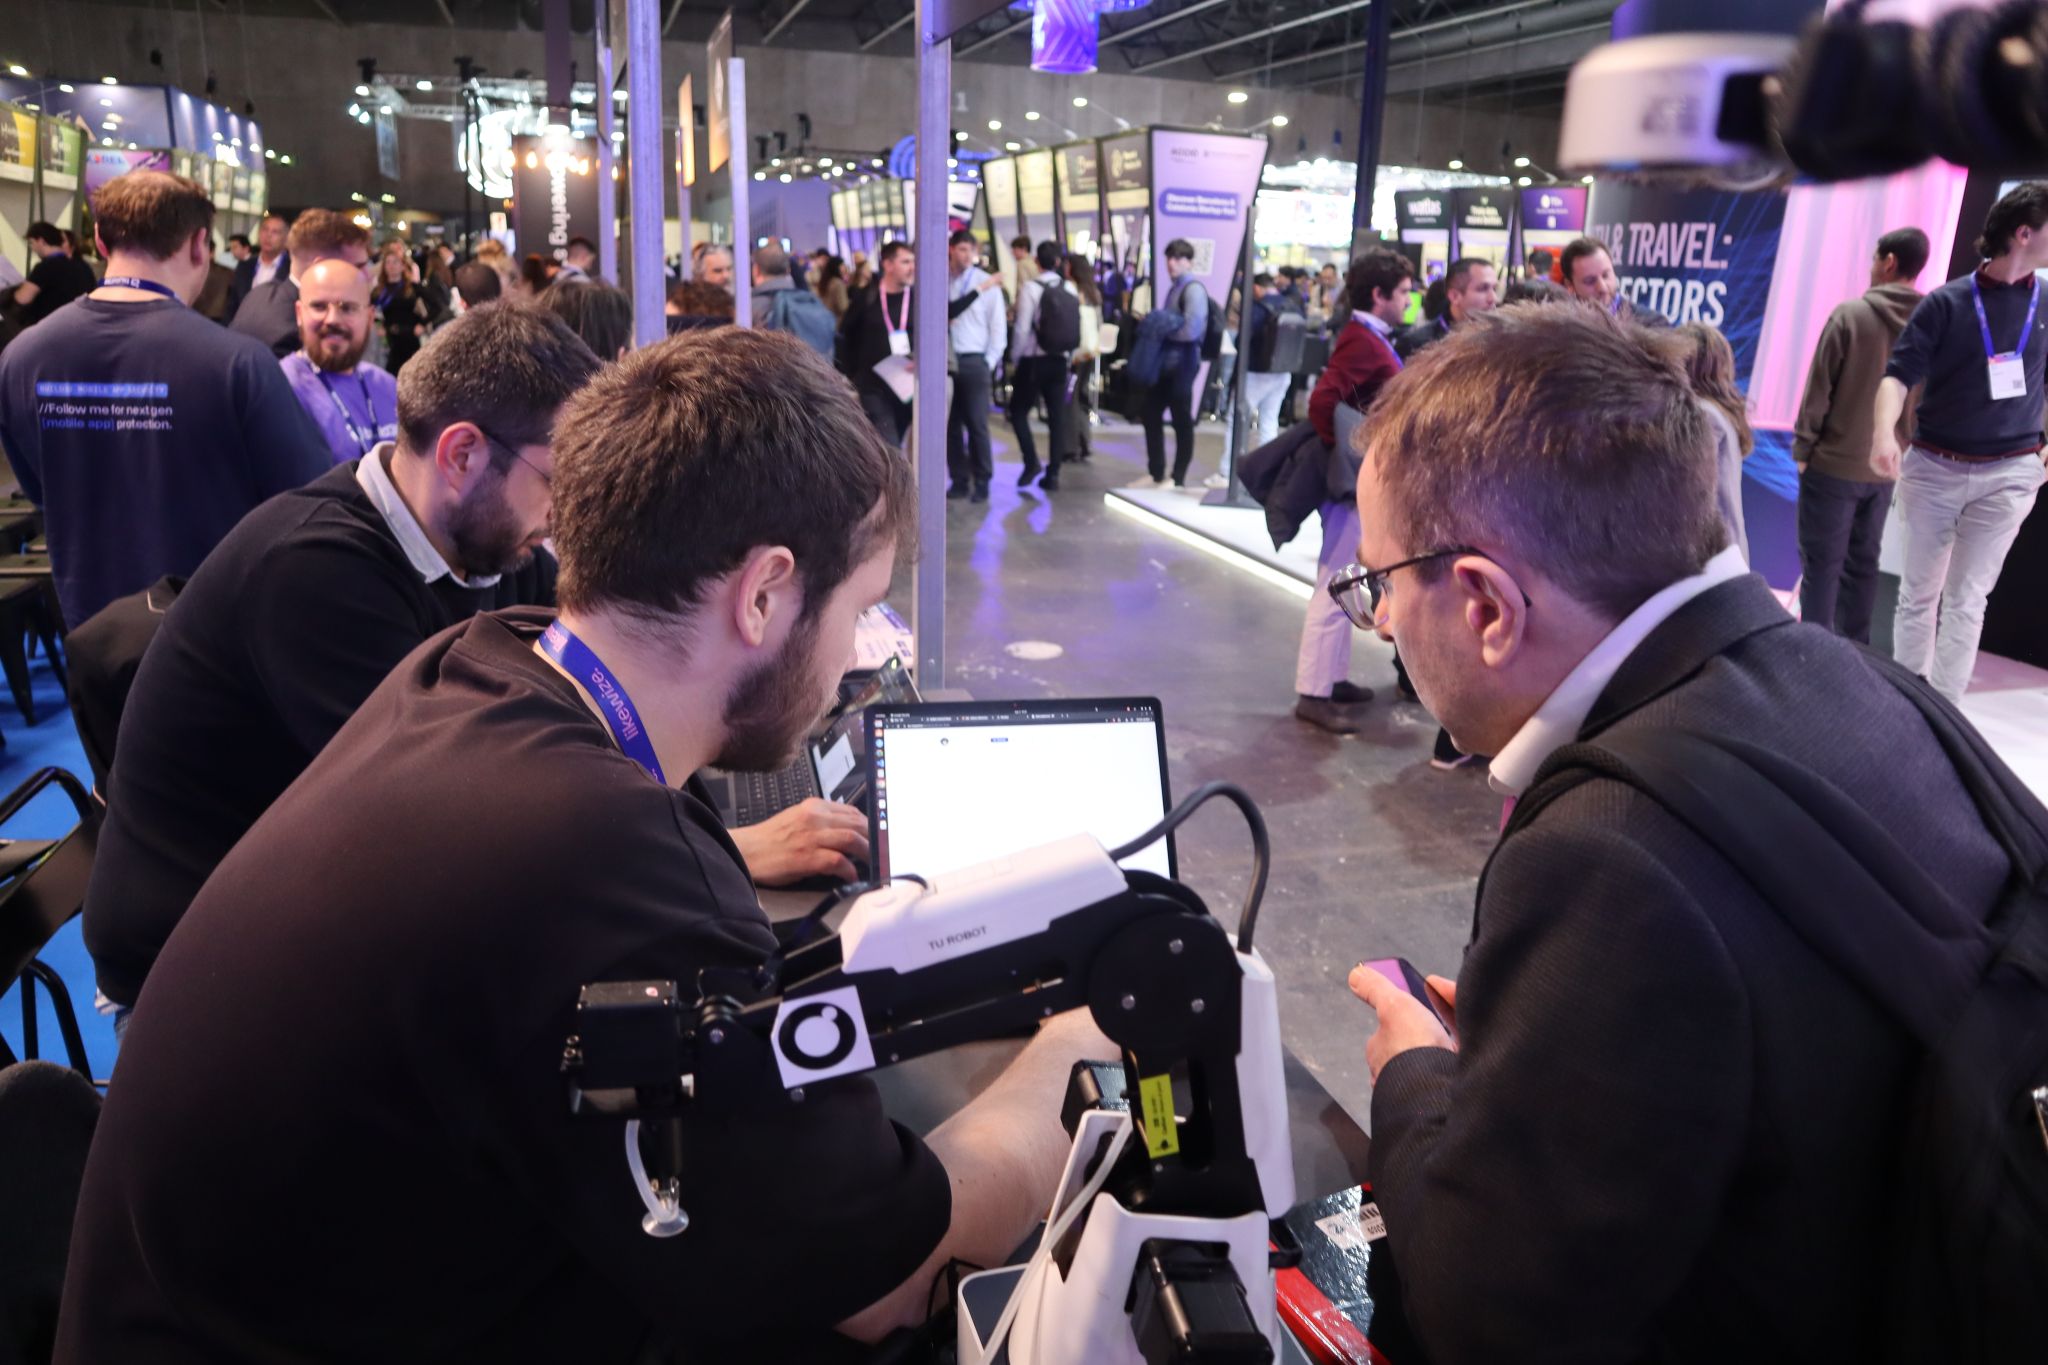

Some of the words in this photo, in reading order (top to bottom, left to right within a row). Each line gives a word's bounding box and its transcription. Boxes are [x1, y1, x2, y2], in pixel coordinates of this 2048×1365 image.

[1628, 222, 1733, 270] TRAVEL:
[1616, 276, 1728, 328] ECTORS
[89, 406, 109, 415] me
[111, 403, 124, 415] for
[126, 404, 150, 415] next
[150, 406, 173, 417] gen
[116, 418, 172, 431] protection.
[591, 667, 639, 741] likewize.
[928, 938, 945, 951] TU
[946, 925, 987, 946] ROBOT
